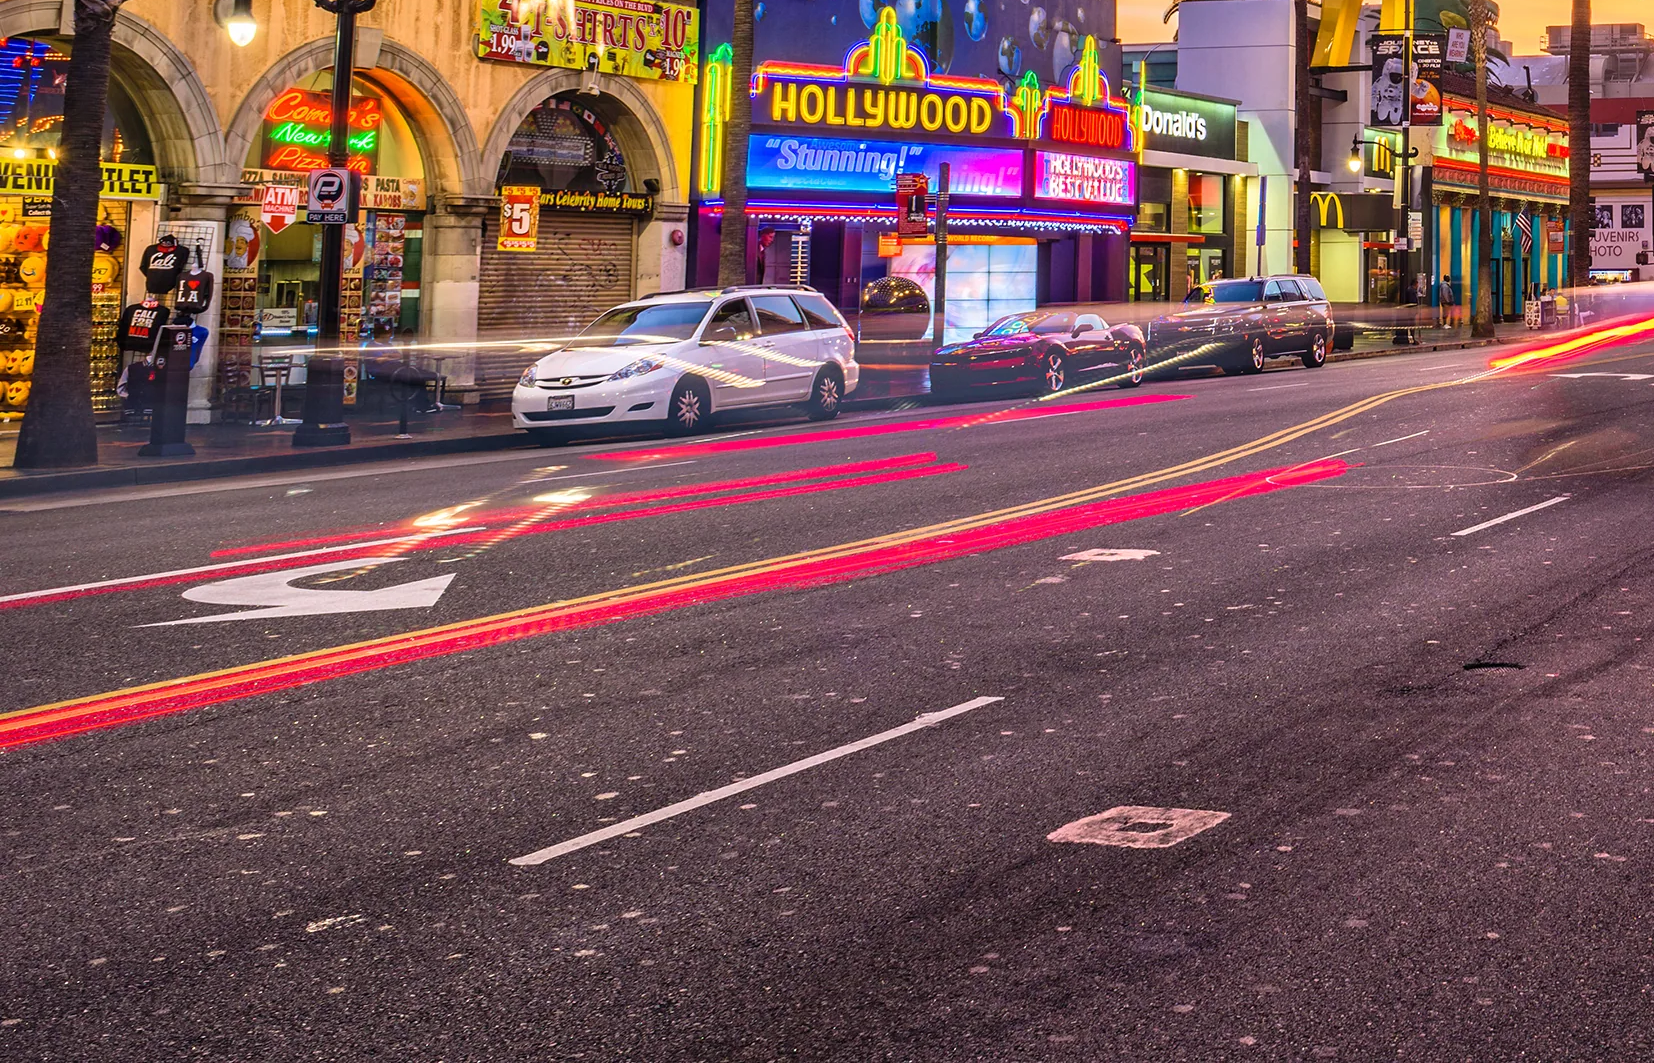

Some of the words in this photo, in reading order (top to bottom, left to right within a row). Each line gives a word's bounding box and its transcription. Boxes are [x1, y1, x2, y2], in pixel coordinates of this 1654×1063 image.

[613, 0, 623, 8] ON
[624, 0, 636, 10] THE
[269, 92, 380, 128] Com's
[771, 82, 992, 134] HOLLYWOOD
[276, 122, 323, 143] New
[1052, 108, 1123, 148] HOLLYWOOD
[100, 166, 154, 194] TLET
[375, 178, 401, 193] PASTA
[265, 186, 297, 205] ATM
[373, 194, 401, 208] KABOBS
[555, 190, 596, 211] Celebrity
[596, 192, 620, 208] Home
[622, 194, 646, 210] Tours
[263, 204, 295, 213] MACHINE
[308, 213, 323, 222] PAY
[324, 213, 345, 222] HERE
[503, 202, 531, 235] $5
[1589, 231, 1639, 243] UVENIRS
[1590, 245, 1623, 257] HOTO
[150, 252, 177, 269] Cali
[133, 309, 158, 319] CALI
